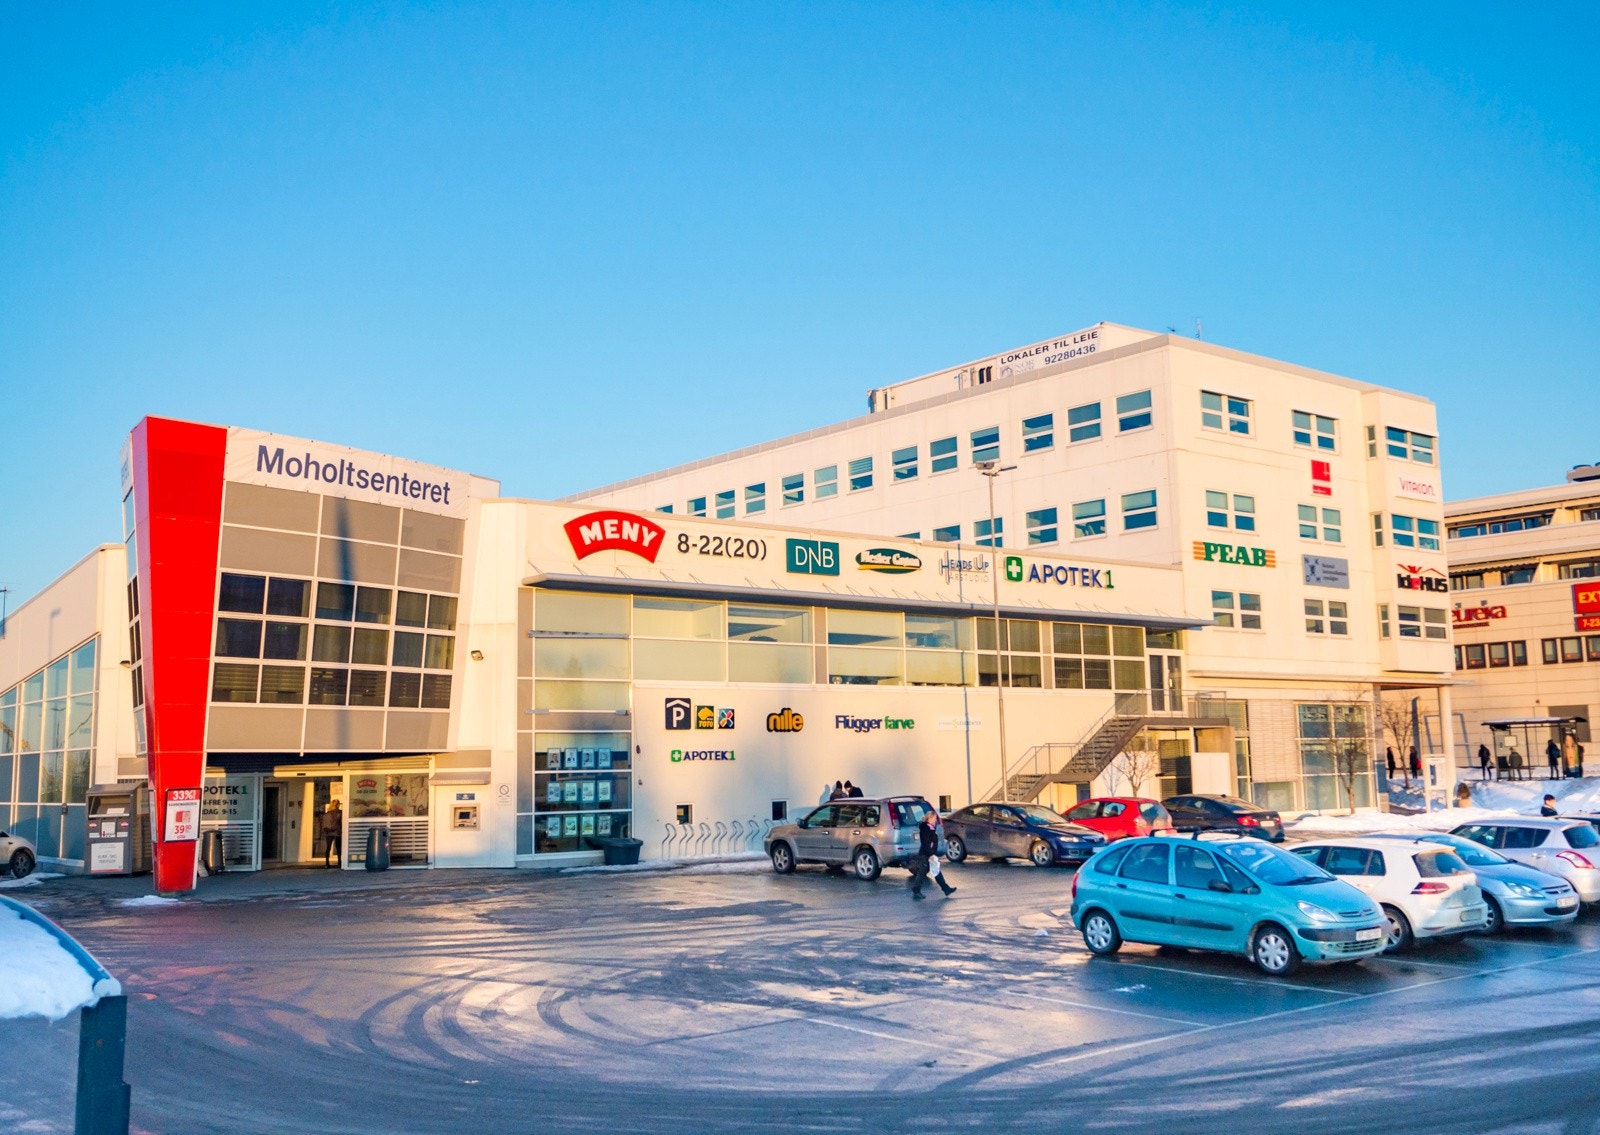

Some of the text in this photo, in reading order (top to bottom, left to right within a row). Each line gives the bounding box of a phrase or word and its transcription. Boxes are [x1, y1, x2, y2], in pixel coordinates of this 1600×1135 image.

[1001, 331, 1099, 365] LOKALER TIL LEIE
[1044, 343, 1096, 365] 92280436
[256, 444, 450, 505] Moholtsenteret
[578, 519, 658, 547] MENY
[677, 533, 767, 560] 8-22(20)
[795, 541, 835, 574] DNB
[1203, 542, 1267, 567] PEAB
[1029, 563, 1115, 588] APOTEK 1
[767, 708, 804, 732] nille
[835, 715, 915, 733] Flügger farve
[683, 751, 736, 761] APOTEK 1
[204, 786, 249, 794] POTEK 1
